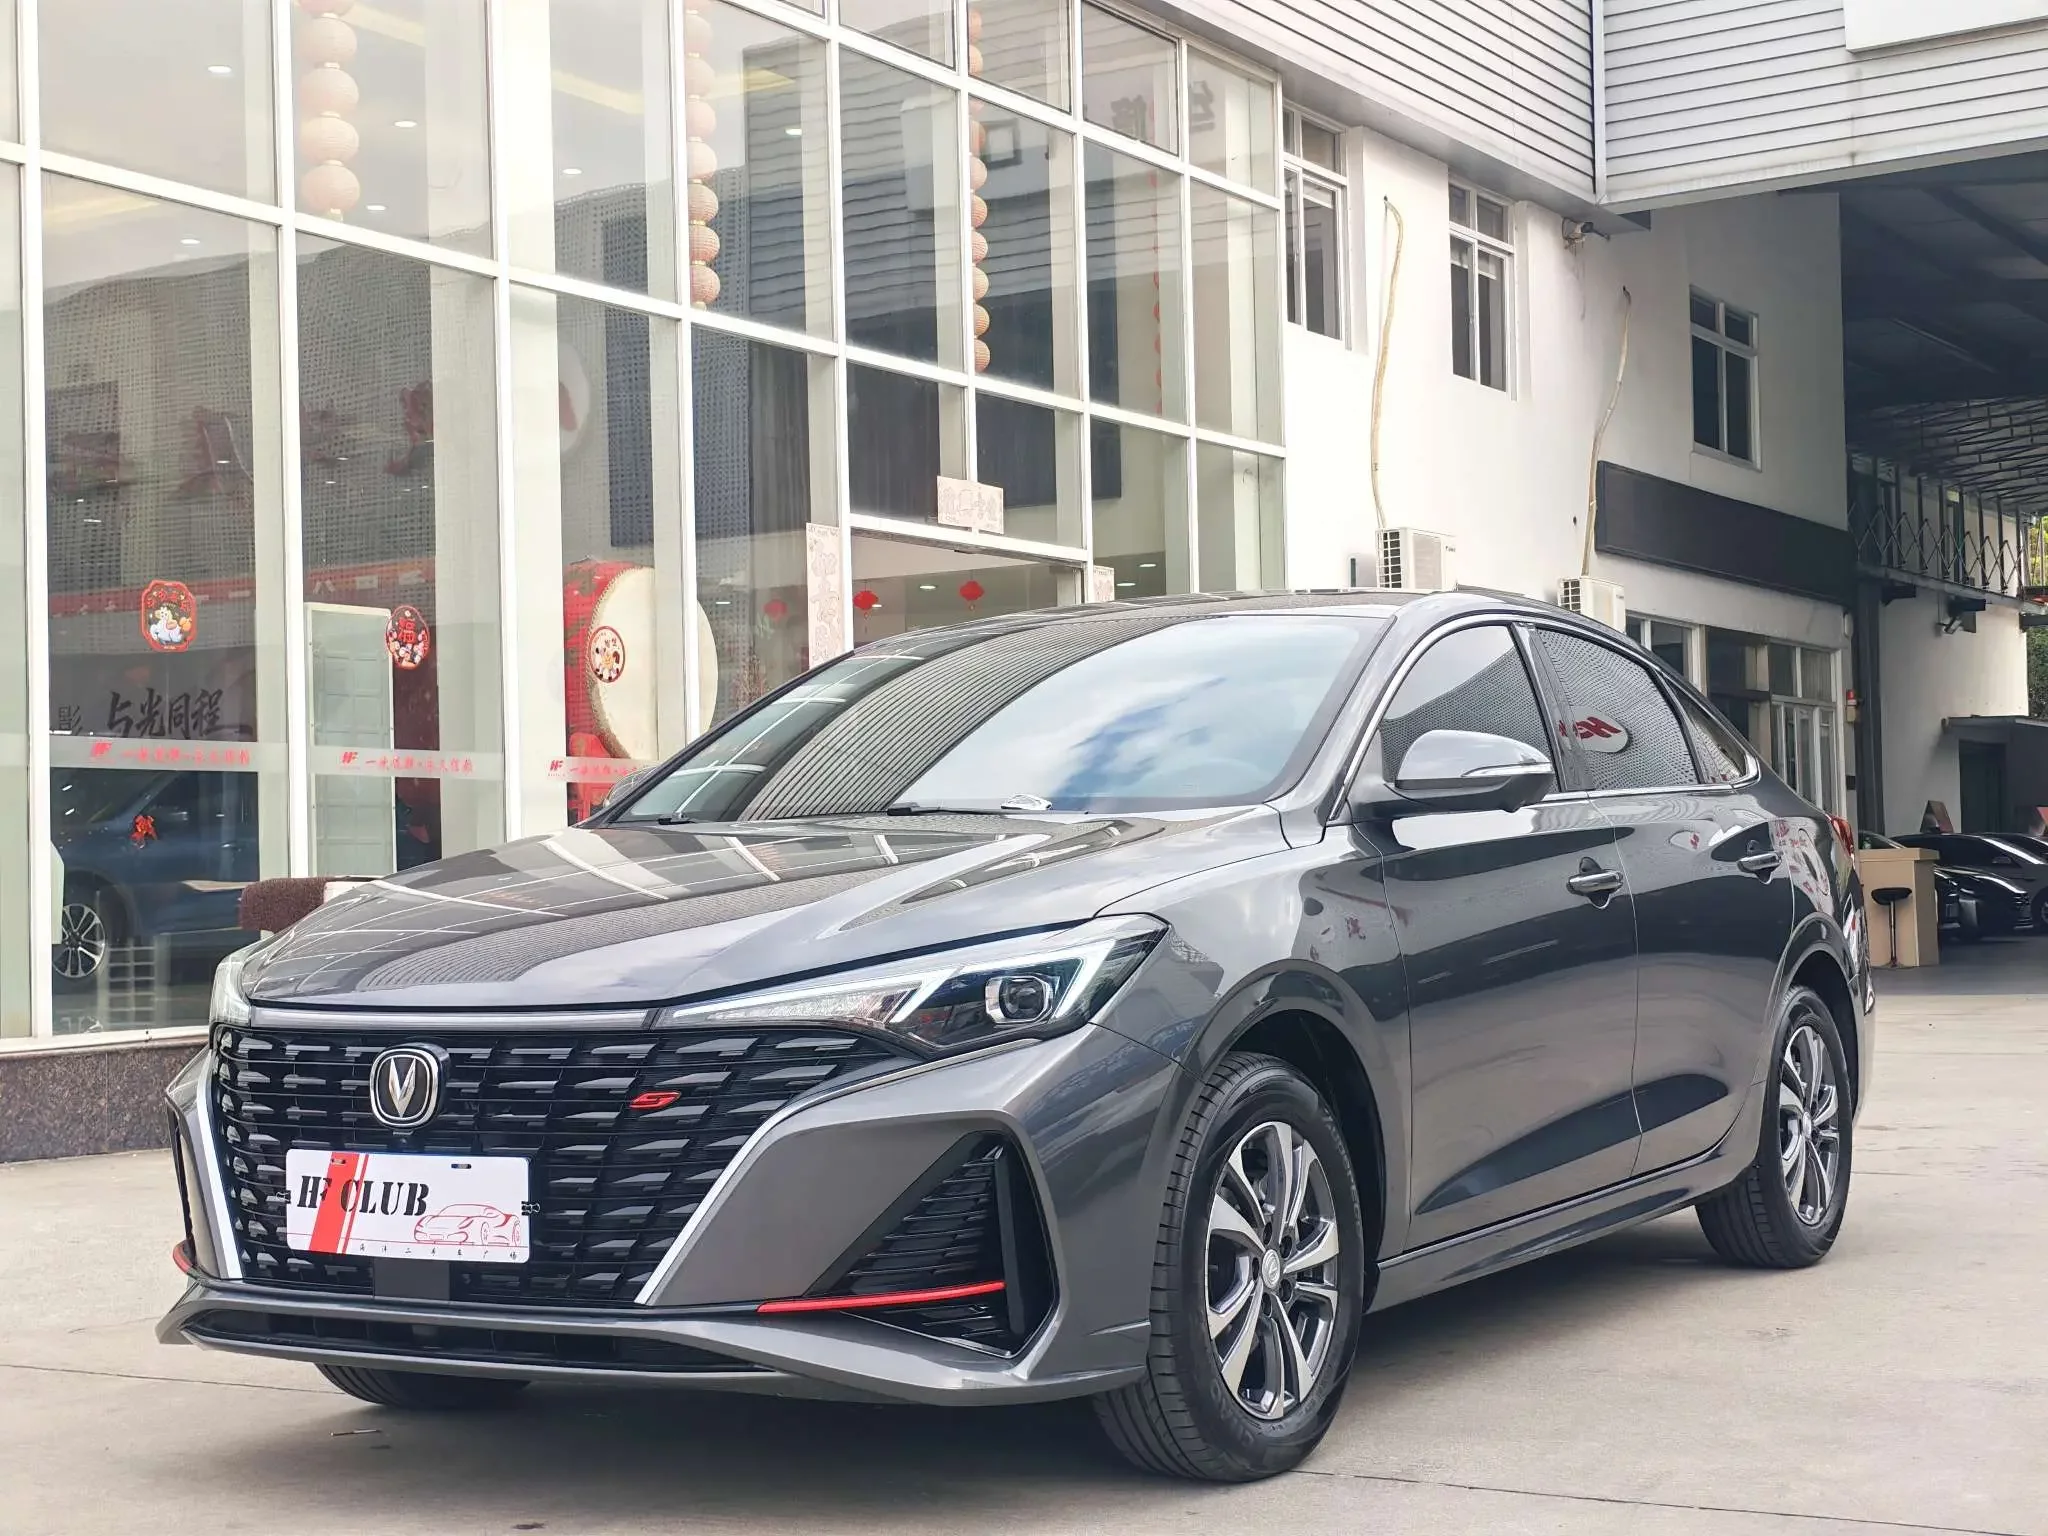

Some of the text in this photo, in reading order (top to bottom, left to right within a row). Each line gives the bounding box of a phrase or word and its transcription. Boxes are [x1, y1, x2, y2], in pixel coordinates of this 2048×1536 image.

[106, 687, 226, 740] 与光同程
[340, 1178, 430, 1217] CLUB
